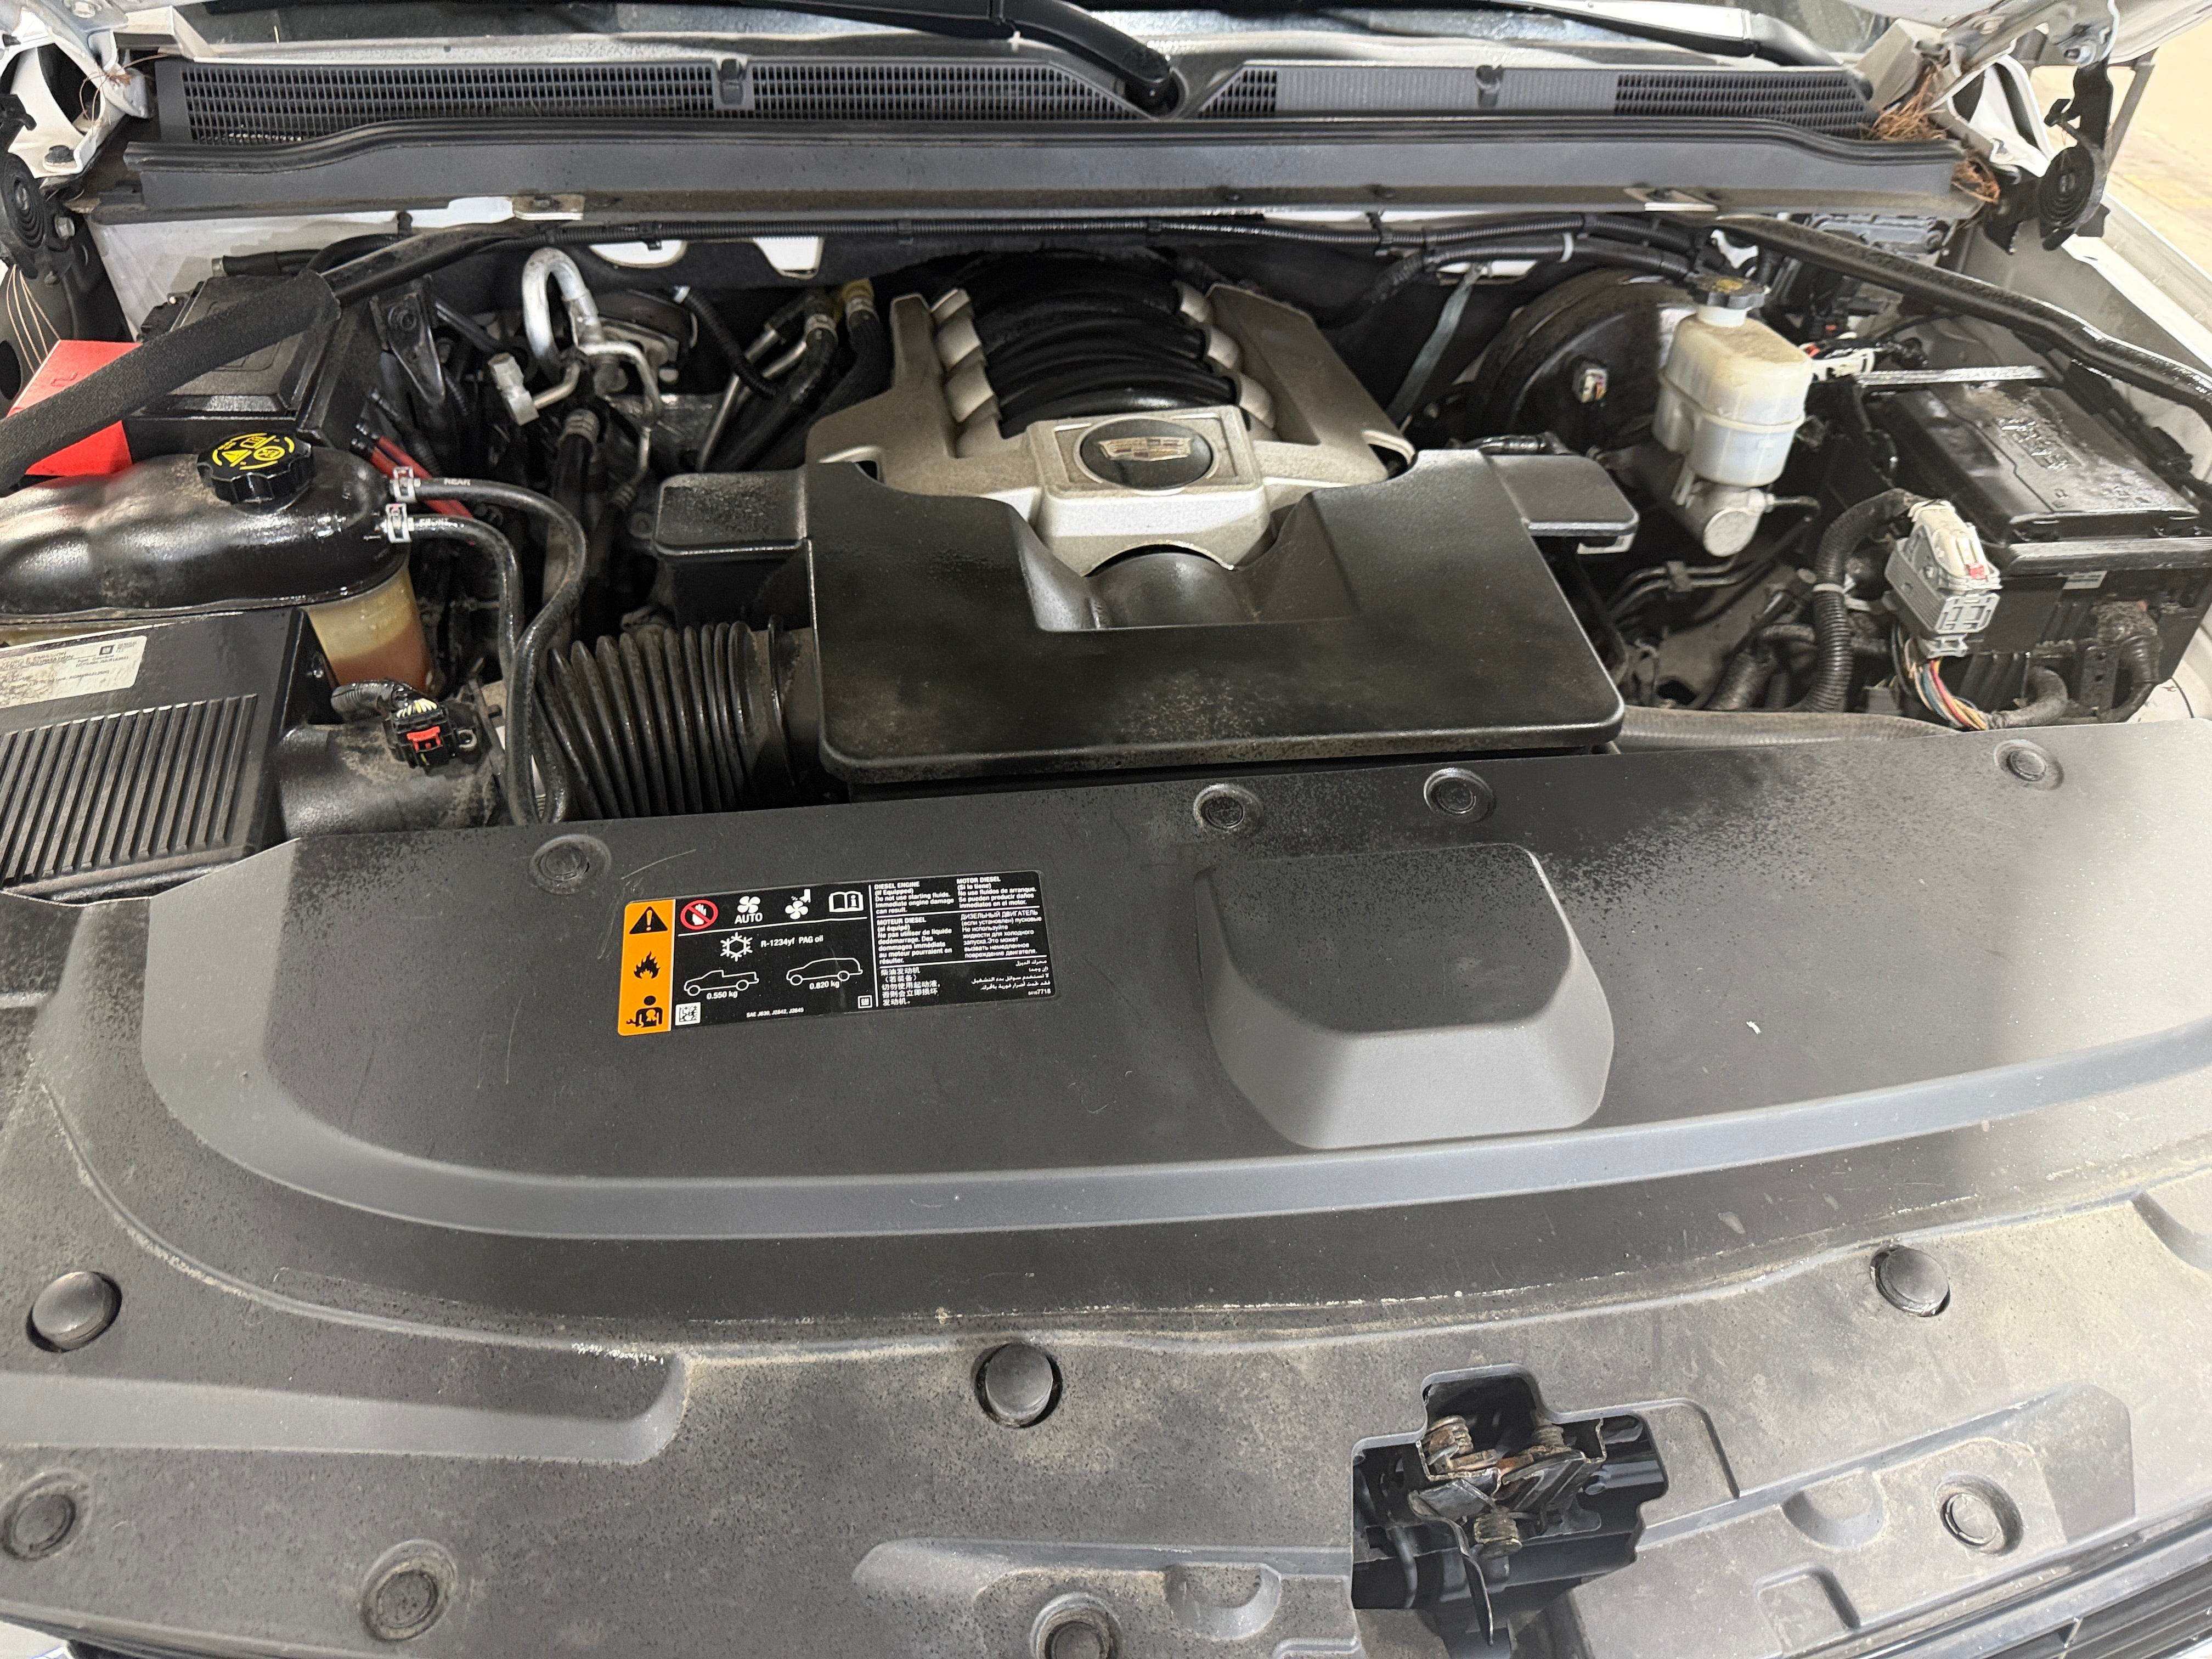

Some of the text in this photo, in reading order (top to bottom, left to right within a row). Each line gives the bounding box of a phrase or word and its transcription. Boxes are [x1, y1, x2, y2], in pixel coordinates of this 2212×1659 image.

[444, 478, 471, 486] REAR
[883, 888, 914, 896] Equipped)
[734, 912, 763, 924] AUTO
[961, 911, 1001, 921] ДИЗЕЛЬНЫЙ
[761, 937, 795, 947] R-1234yf
[798, 936, 814, 944] PAG
[878, 944, 912, 952] dommages
[912, 948, 943, 957] pourraient
[881, 967, 921, 977] 柴油发动机
[707, 990, 738, 1000] 0.550 kg
